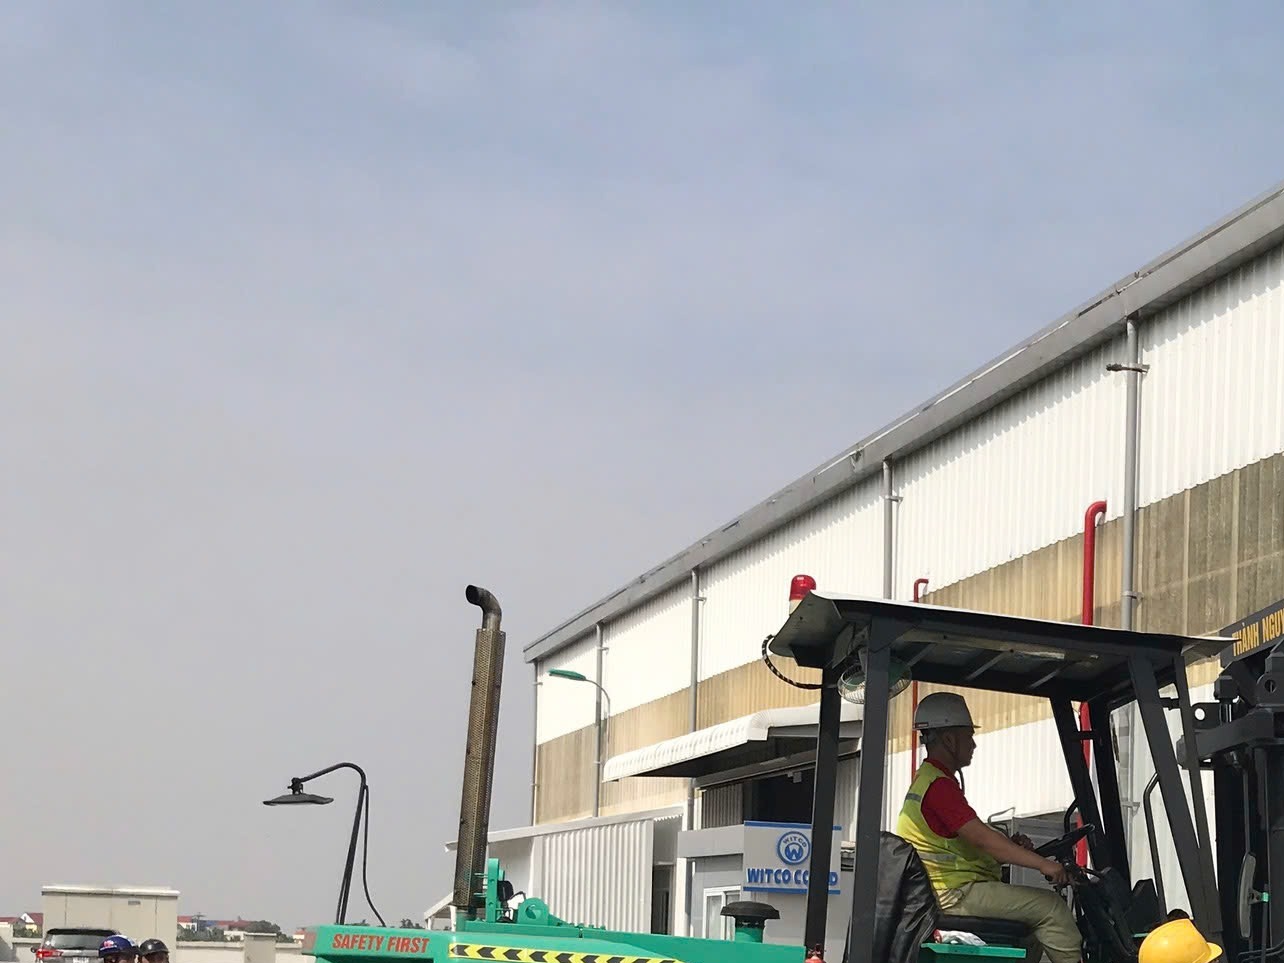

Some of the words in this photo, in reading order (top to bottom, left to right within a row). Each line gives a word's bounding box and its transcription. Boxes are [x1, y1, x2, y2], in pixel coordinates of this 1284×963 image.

[782, 836, 807, 848] WITCO
[747, 867, 791, 884] WITCO
[332, 933, 384, 951] SAFETY
[387, 936, 430, 953] FIRST
